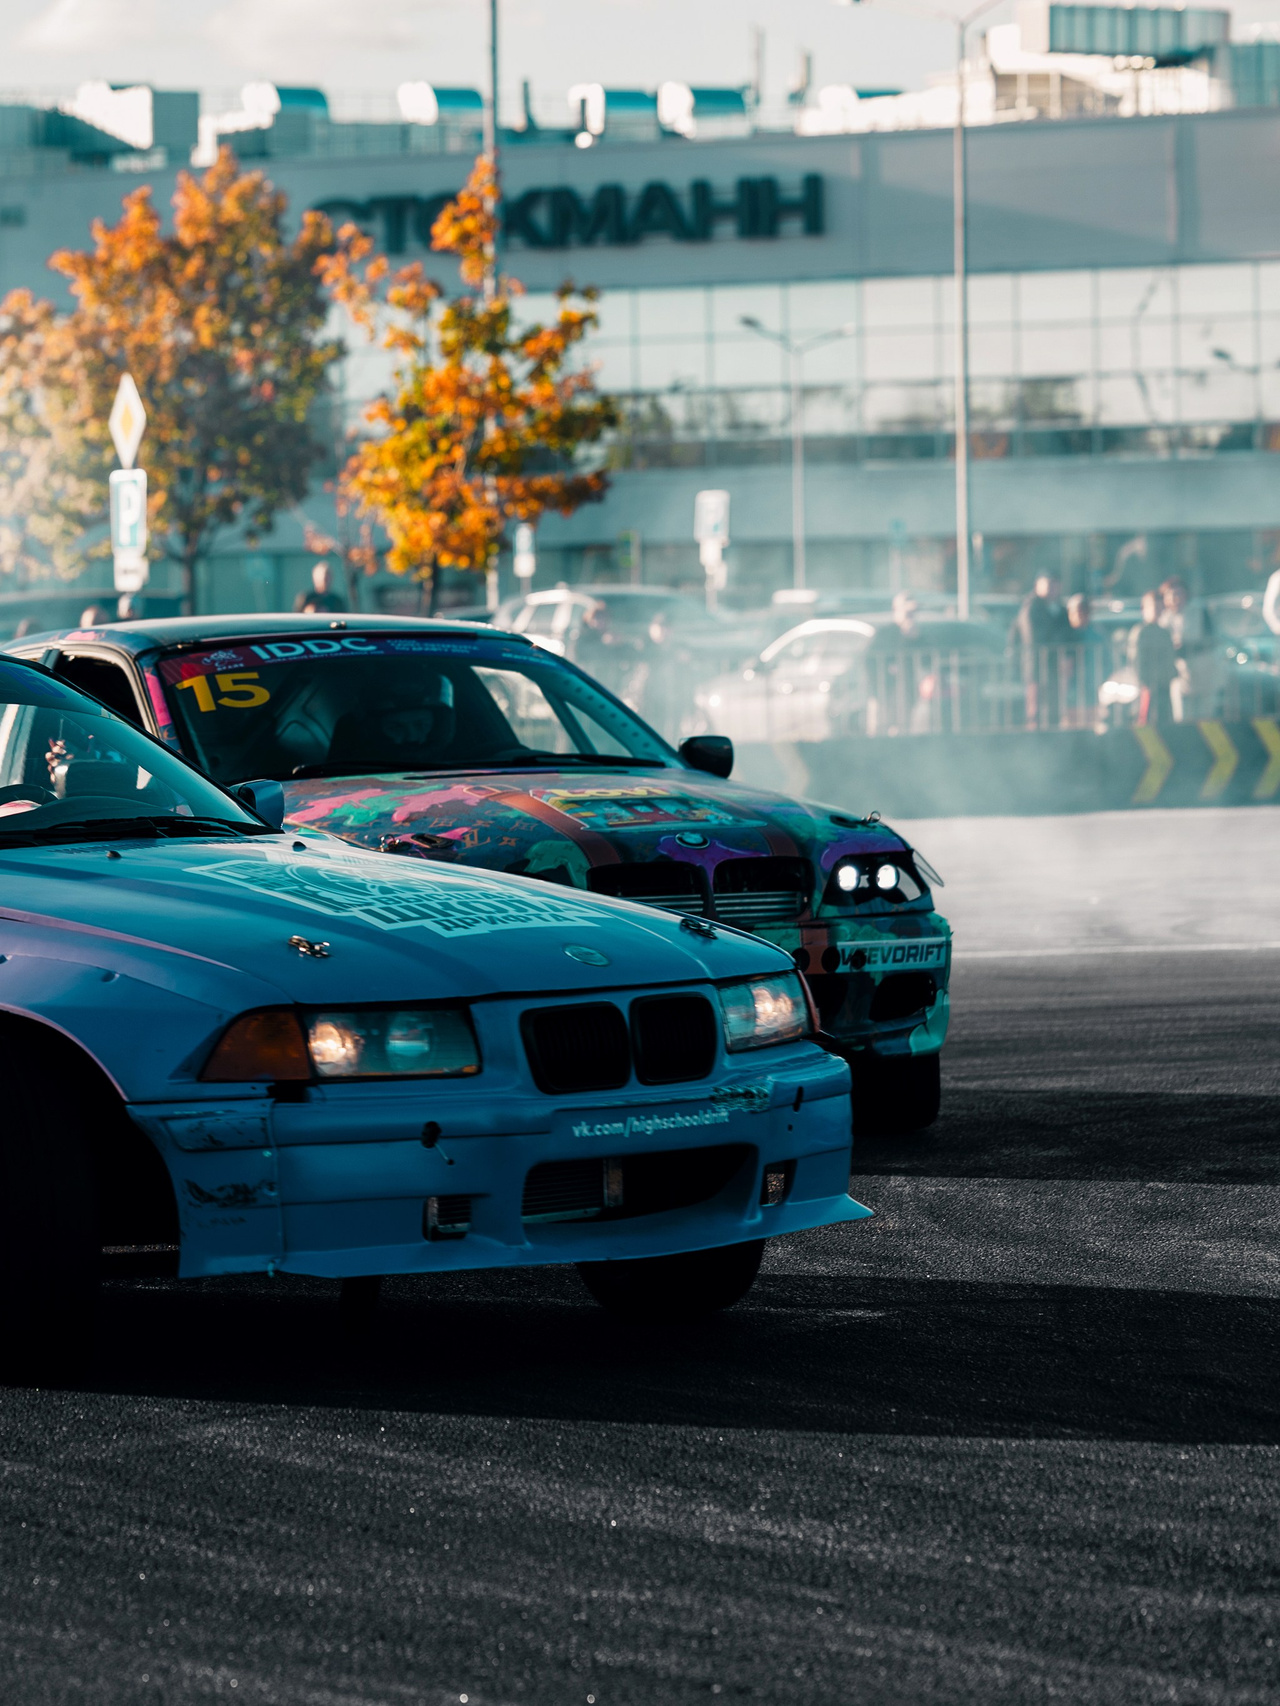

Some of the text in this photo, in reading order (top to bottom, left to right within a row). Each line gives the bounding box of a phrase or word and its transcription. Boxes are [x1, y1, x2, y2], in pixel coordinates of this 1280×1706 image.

[119, 482, 141, 544] P
[250, 637, 377, 660] IDDC
[176, 672, 270, 712] 15
[357, 898, 589, 925] ШКОЛА
[431, 912, 576, 932] ДРИФТА
[840, 944, 945, 966] VEVDRIFT
[572, 1109, 730, 1138] vk.com/highschooldrift
